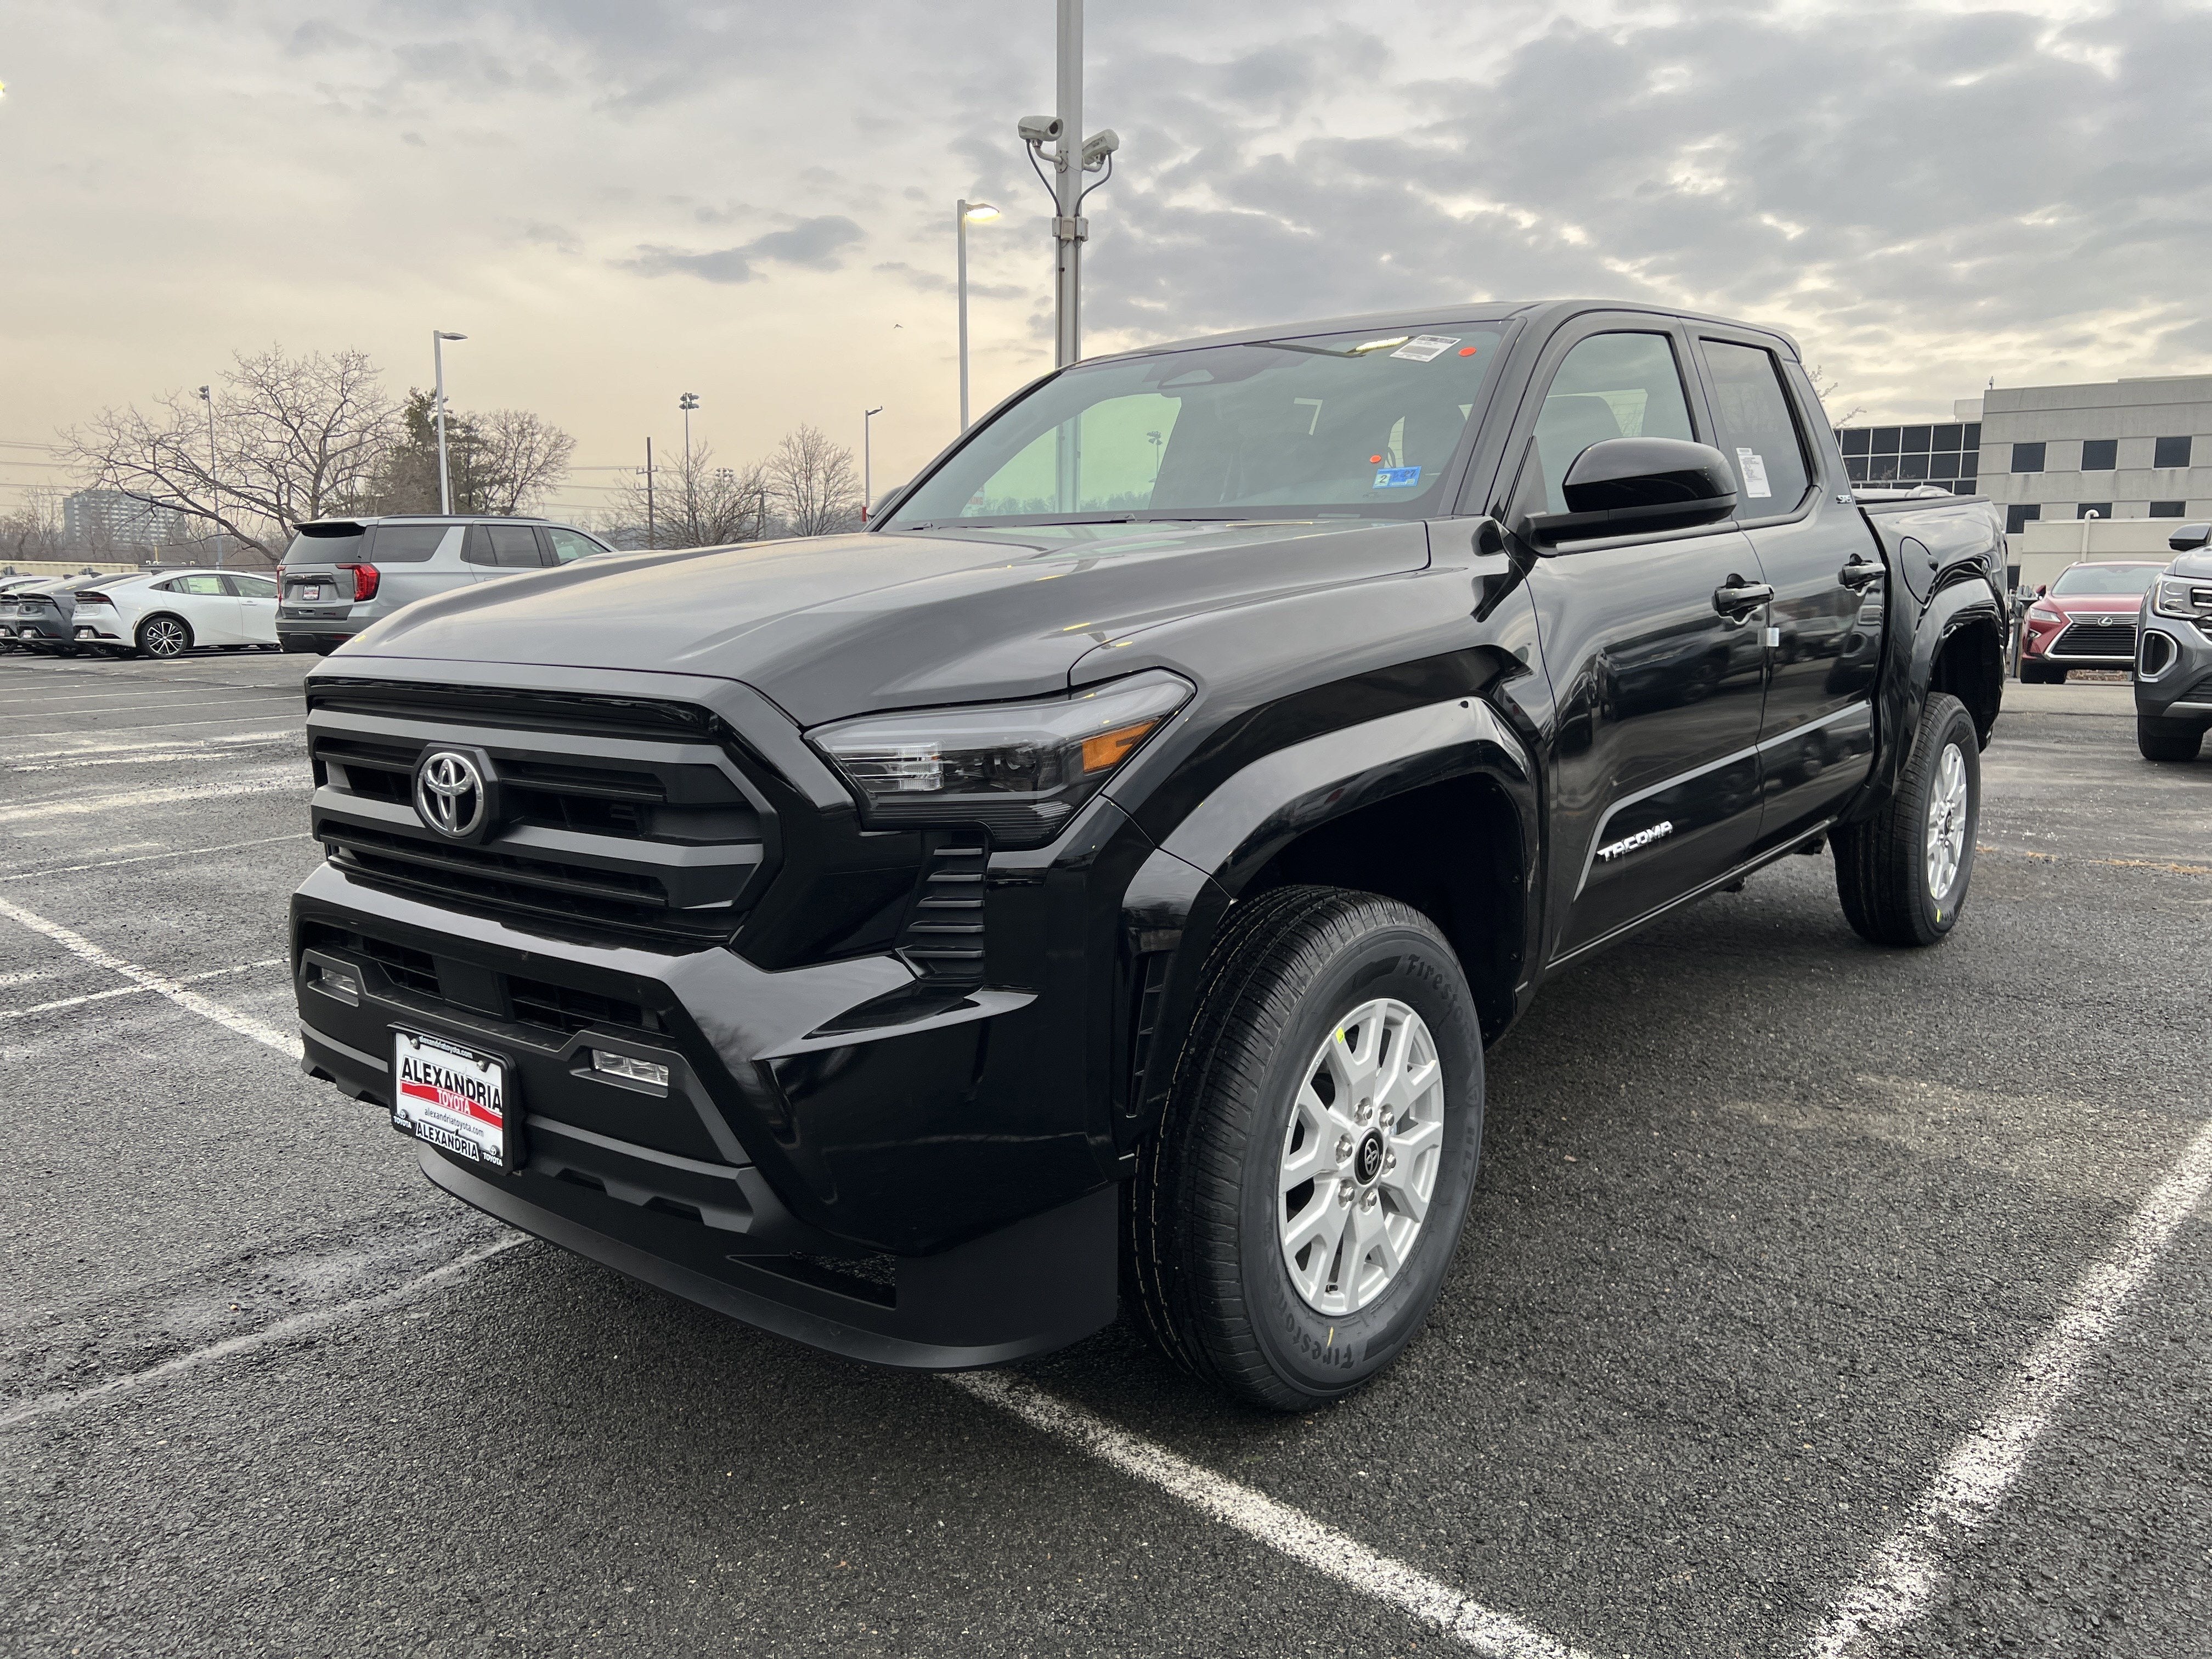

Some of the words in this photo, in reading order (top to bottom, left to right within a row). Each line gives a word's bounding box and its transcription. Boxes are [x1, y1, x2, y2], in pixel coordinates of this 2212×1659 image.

[1379, 475, 1387, 483] 2
[1597, 821, 1673, 862] TACOMA
[1406, 954, 1474, 1045] Firesto
[402, 1057, 503, 1113] ALEXANDRIA
[437, 1089, 471, 1115] TOYOTA
[393, 1116, 412, 1129] TOYOTA
[424, 1108, 484, 1137] alexandriatoyota.com
[416, 1122, 479, 1161] ALEXANDRIA
[483, 1152, 503, 1167] TOYOTA
